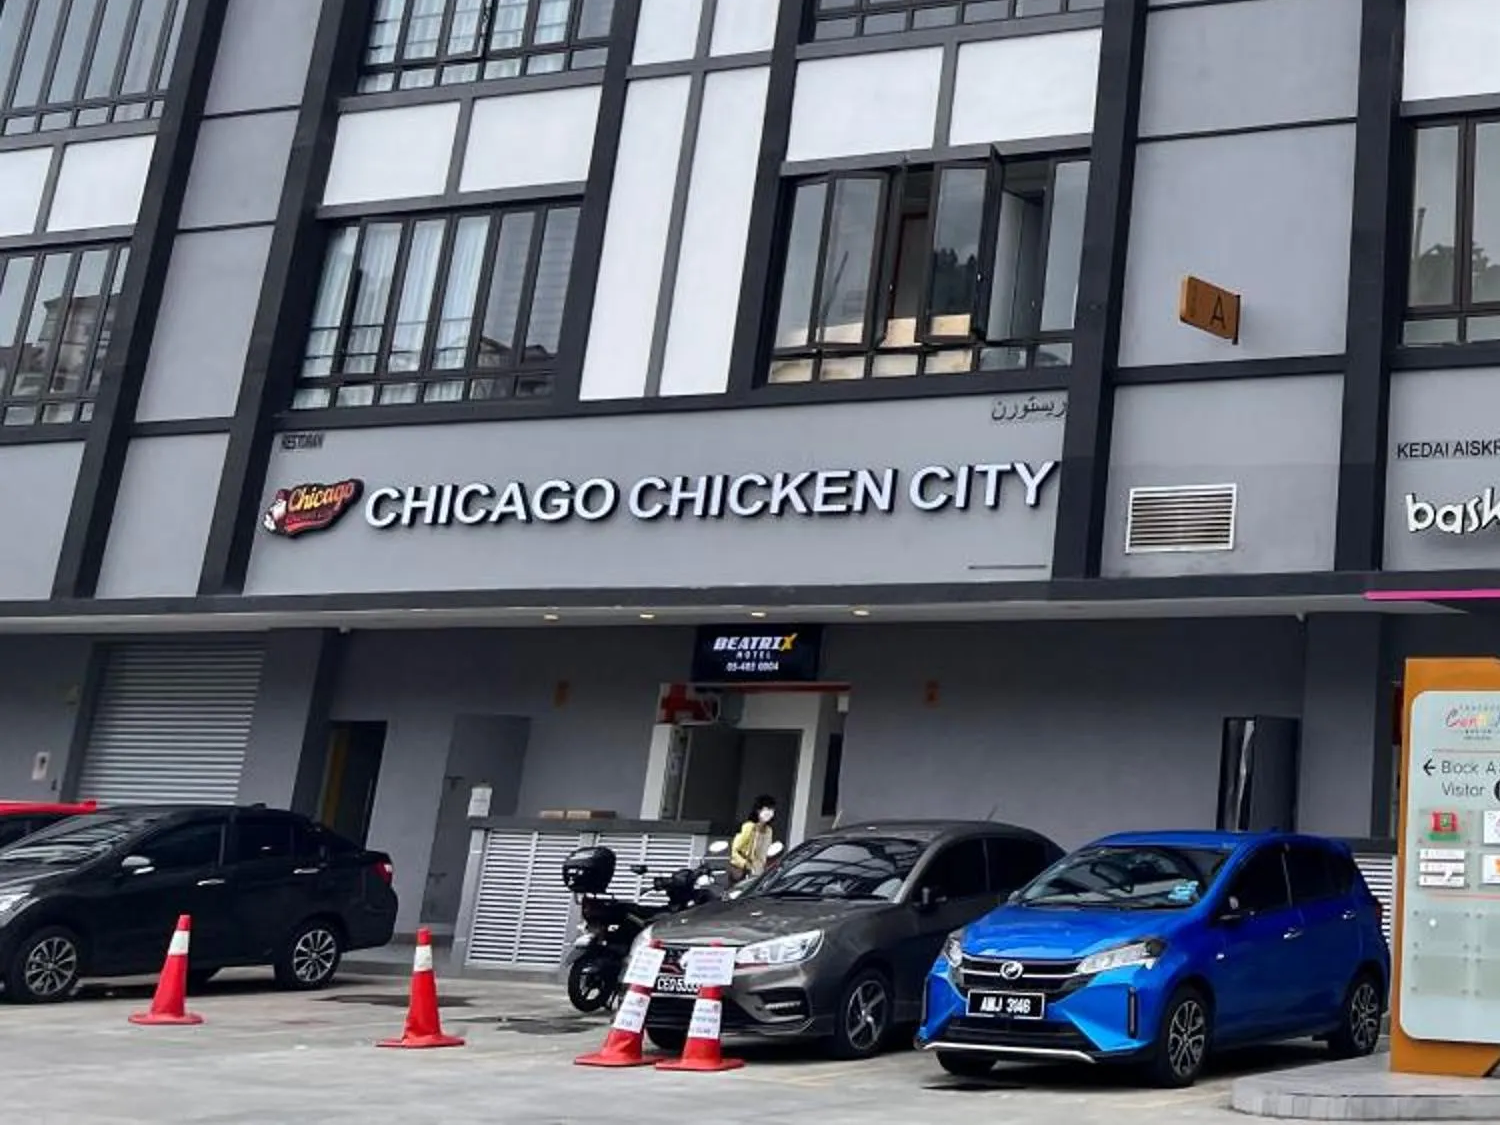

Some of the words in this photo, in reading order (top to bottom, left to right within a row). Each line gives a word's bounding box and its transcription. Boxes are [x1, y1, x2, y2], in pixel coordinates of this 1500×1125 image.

[1209, 292, 1227, 331] A
[1397, 442, 1449, 459] KEDAI
[288, 482, 355, 512] Chicago
[365, 477, 618, 528] CHICAGO
[629, 467, 897, 520] CHICKEN
[909, 460, 1062, 511] CITY
[713, 633, 798, 651] BEATRIX
[1441, 781, 1486, 797] Visitor
